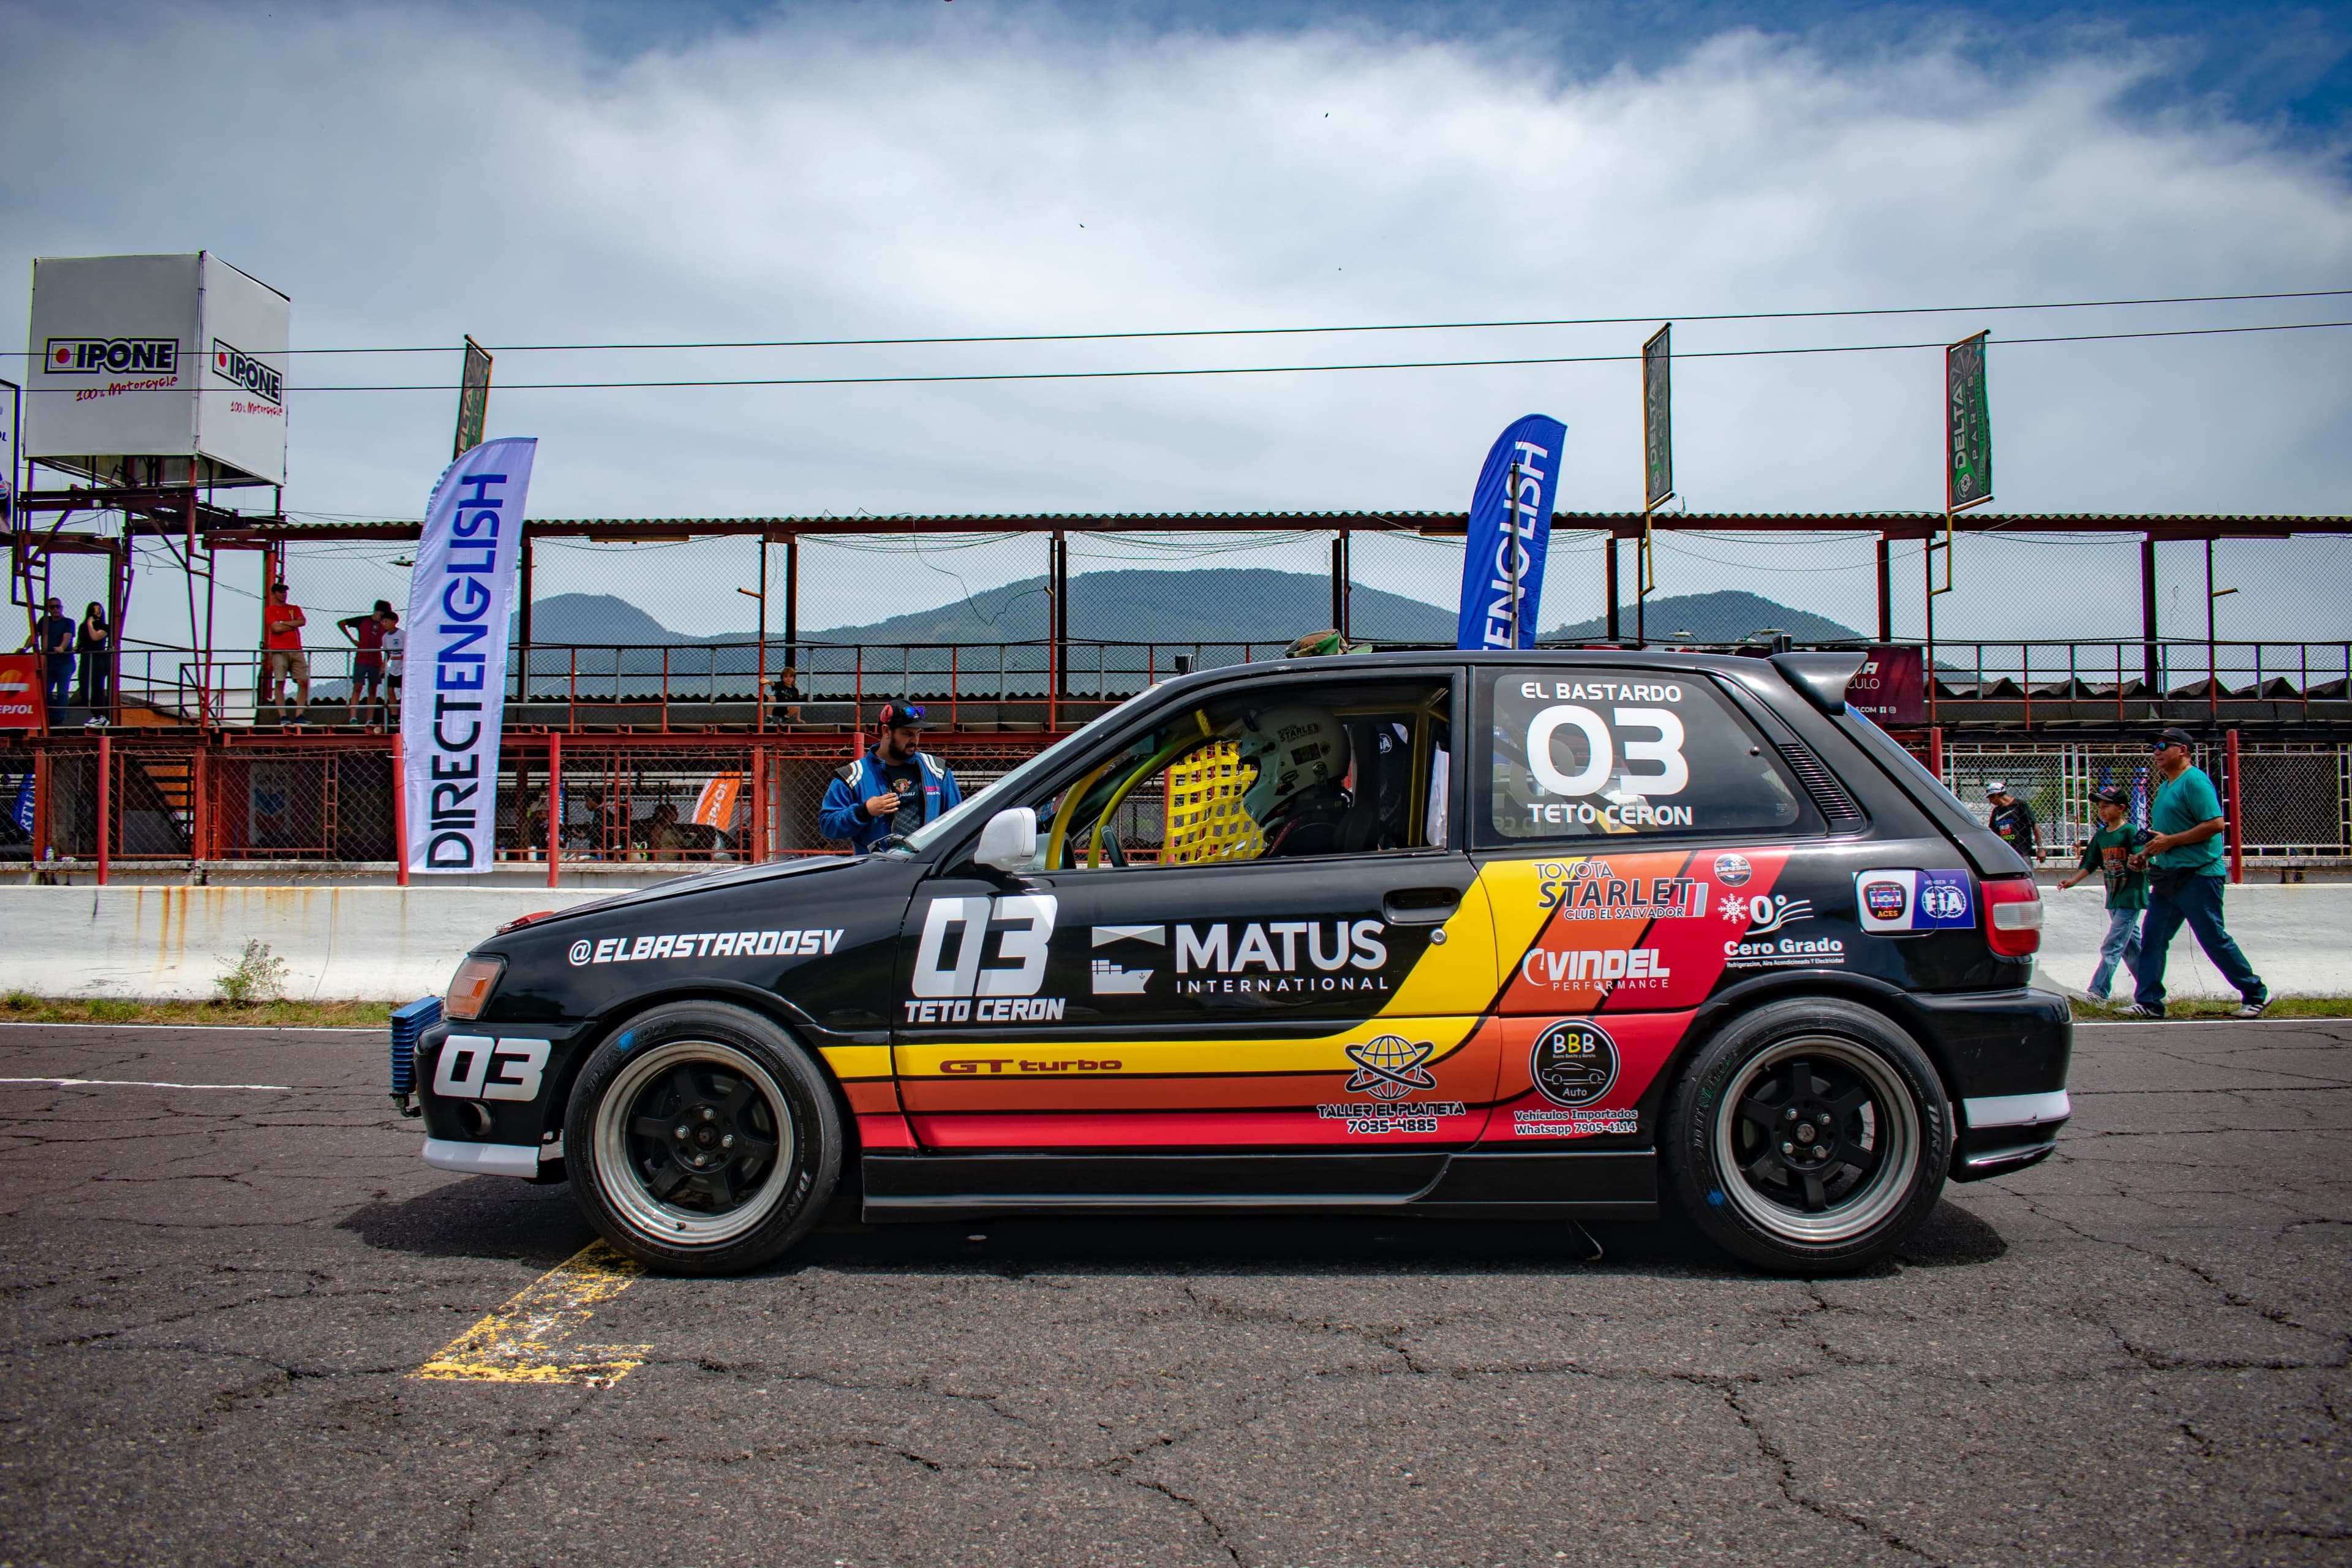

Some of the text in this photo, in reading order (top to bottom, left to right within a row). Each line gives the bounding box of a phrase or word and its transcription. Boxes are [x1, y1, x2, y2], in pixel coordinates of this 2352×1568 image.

[77, 344, 173, 368] IPONE
[108, 376, 178, 396] Motorcycle
[230, 353, 280, 400] IPONE
[1953, 383, 1966, 469] DELTA
[1967, 375, 1978, 460] PART'S
[1483, 440, 1548, 650] ENGLISH
[1521, 682, 1682, 703] EL BASTARDO
[1526, 704, 1689, 796] 03
[1527, 804, 1693, 826] TETO CERON
[1534, 861, 1615, 880] TOYOTA
[1538, 878, 1694, 909] STARLET
[1564, 907, 1684, 921] CLUB EL SALVADOR
[569, 929, 845, 966] @ELBASTARDOSV
[912, 894, 1058, 998] 03
[1175, 919, 1387, 974] MATUS
[1724, 937, 1843, 956] Cero Grado
[1547, 949, 1670, 980] VINDEL
[1176, 976, 1389, 993] INTERNATIONAL
[905, 997, 1066, 1022] TETO CERON
[1553, 1033, 1596, 1054] BBB
[433, 1035, 552, 1101] 03
[940, 1058, 1123, 1074] GT turbo
[1562, 1087, 1587, 1096] Auto
[1317, 1101, 1466, 1118] TALLER EL PLANETA
[1514, 1108, 1638, 1121] Vehículos Importados
[1348, 1117, 1437, 1134] 7035-4885
[1514, 1121, 1637, 1136] Whatsapp 7905-4114
